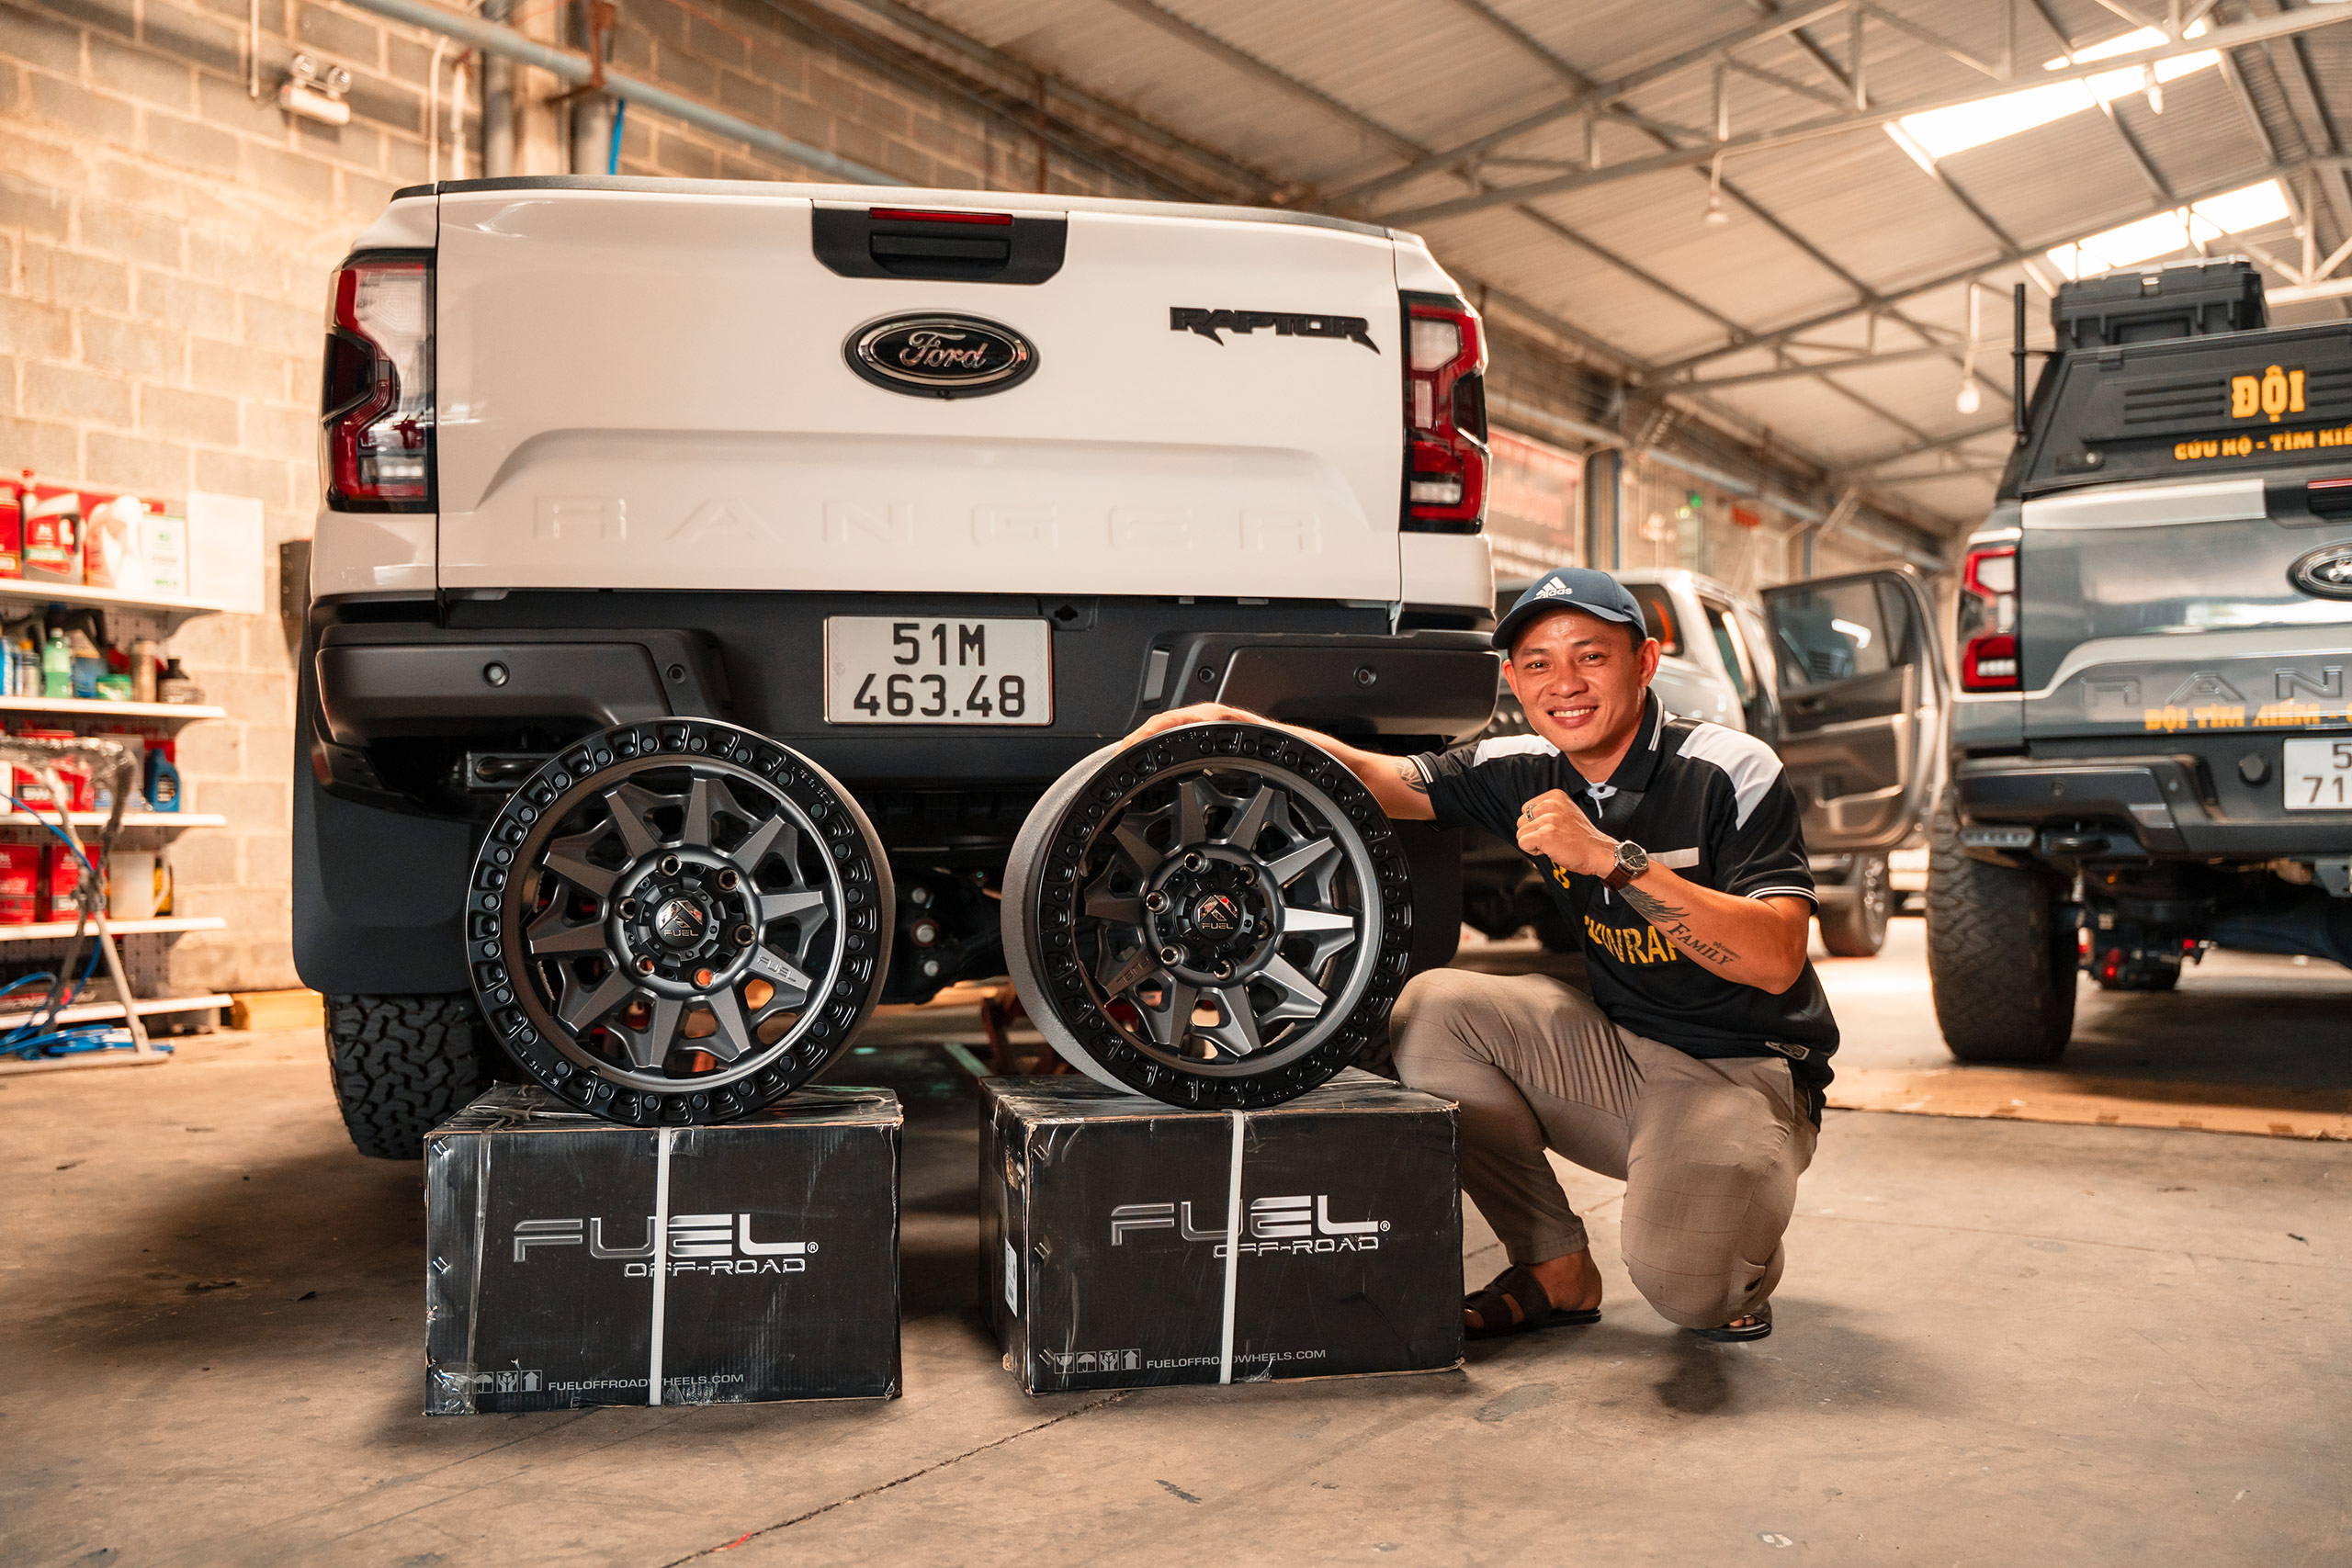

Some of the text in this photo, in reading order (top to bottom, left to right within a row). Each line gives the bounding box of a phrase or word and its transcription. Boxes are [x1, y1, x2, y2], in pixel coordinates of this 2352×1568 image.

[899, 331, 989, 369] Ford
[1170, 307, 1381, 355] RAPTOR
[2232, 364, 2306, 423] ĐỘI
[2269, 430, 2315, 452] TÌM
[533, 494, 1321, 553] RANGER
[893, 623, 985, 666] 51M
[854, 673, 1025, 717] 463.48
[1667, 922, 1734, 965] FAMILY
[757, 954, 797, 983] FUEL
[1147, 1349, 1326, 1369] FUELOFFRODWHEELS.COM
